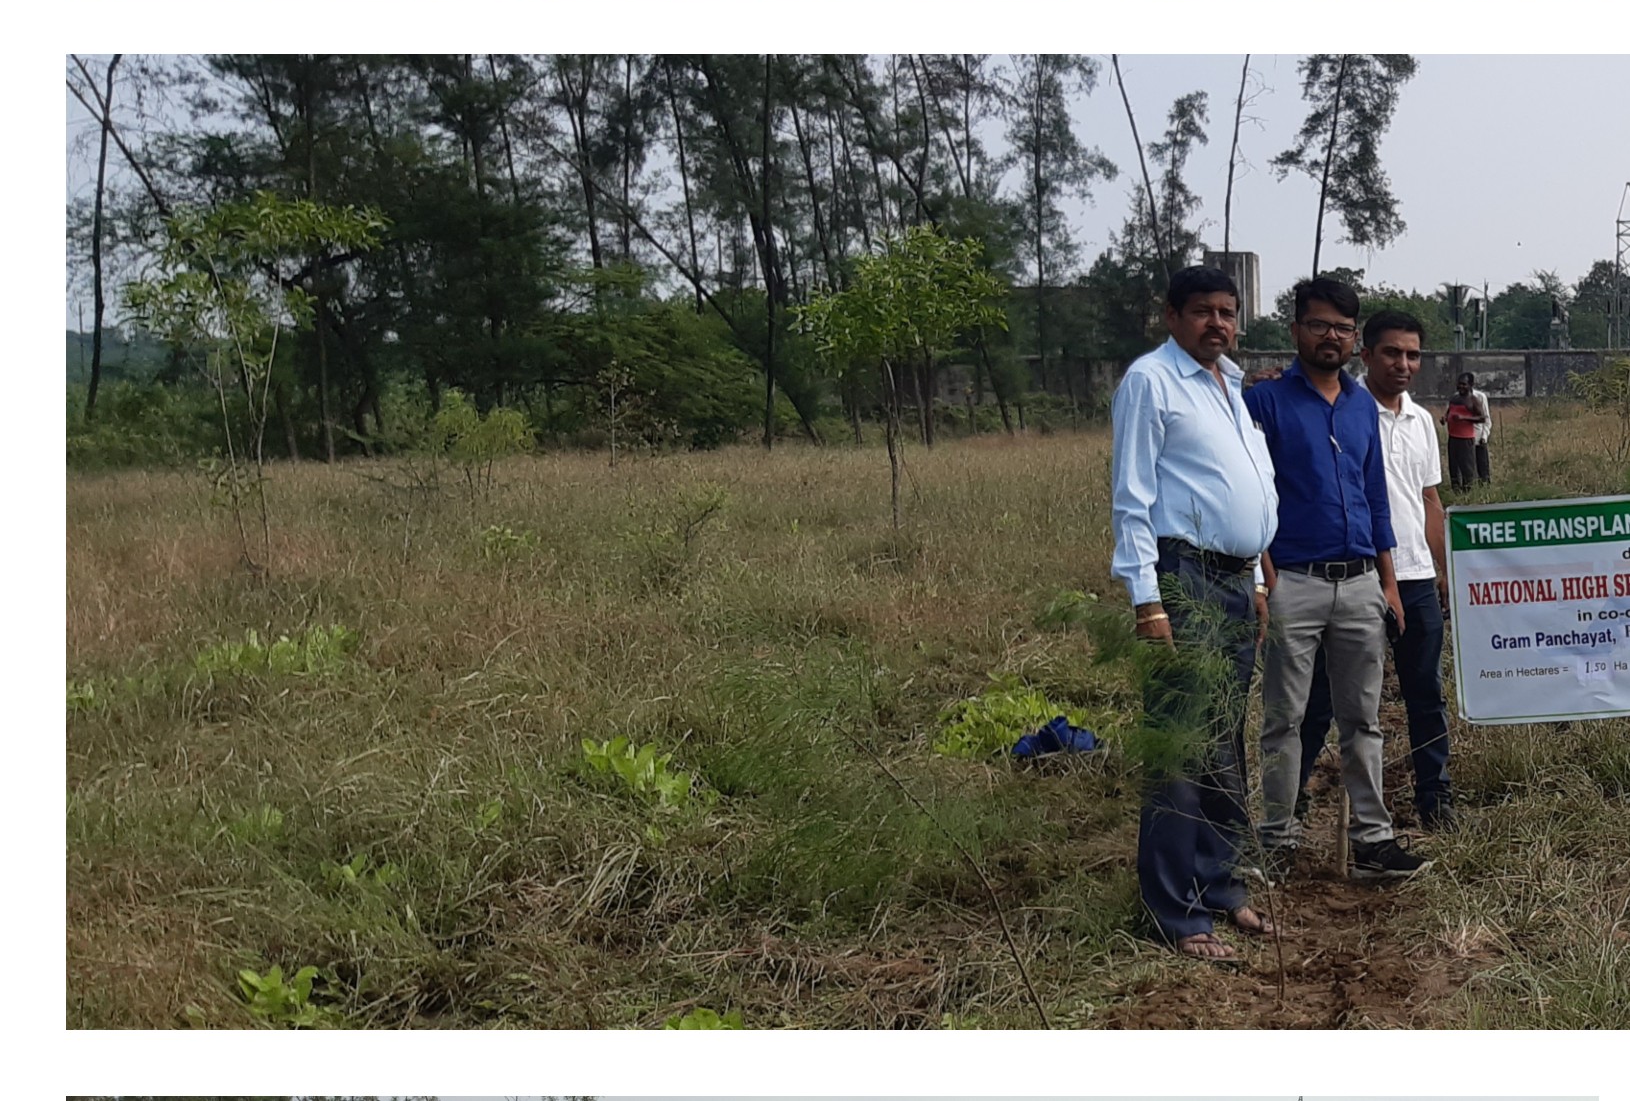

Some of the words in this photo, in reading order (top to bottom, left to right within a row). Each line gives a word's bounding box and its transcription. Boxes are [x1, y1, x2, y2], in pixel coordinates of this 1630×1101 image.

[1466, 521, 1517, 544] TREE
[1468, 578, 1557, 605] NATIONAL
[1561, 575, 1609, 600] HIGH
[1577, 609, 1592, 622] in
[1491, 634, 1531, 650] Gram
[1535, 628, 1617, 648] Panchayat,
[1479, 669, 1502, 679] Area
[1505, 668, 1514, 678] in
[1516, 666, 1560, 677] Hectares
[1614, 661, 1628, 671] Ha
